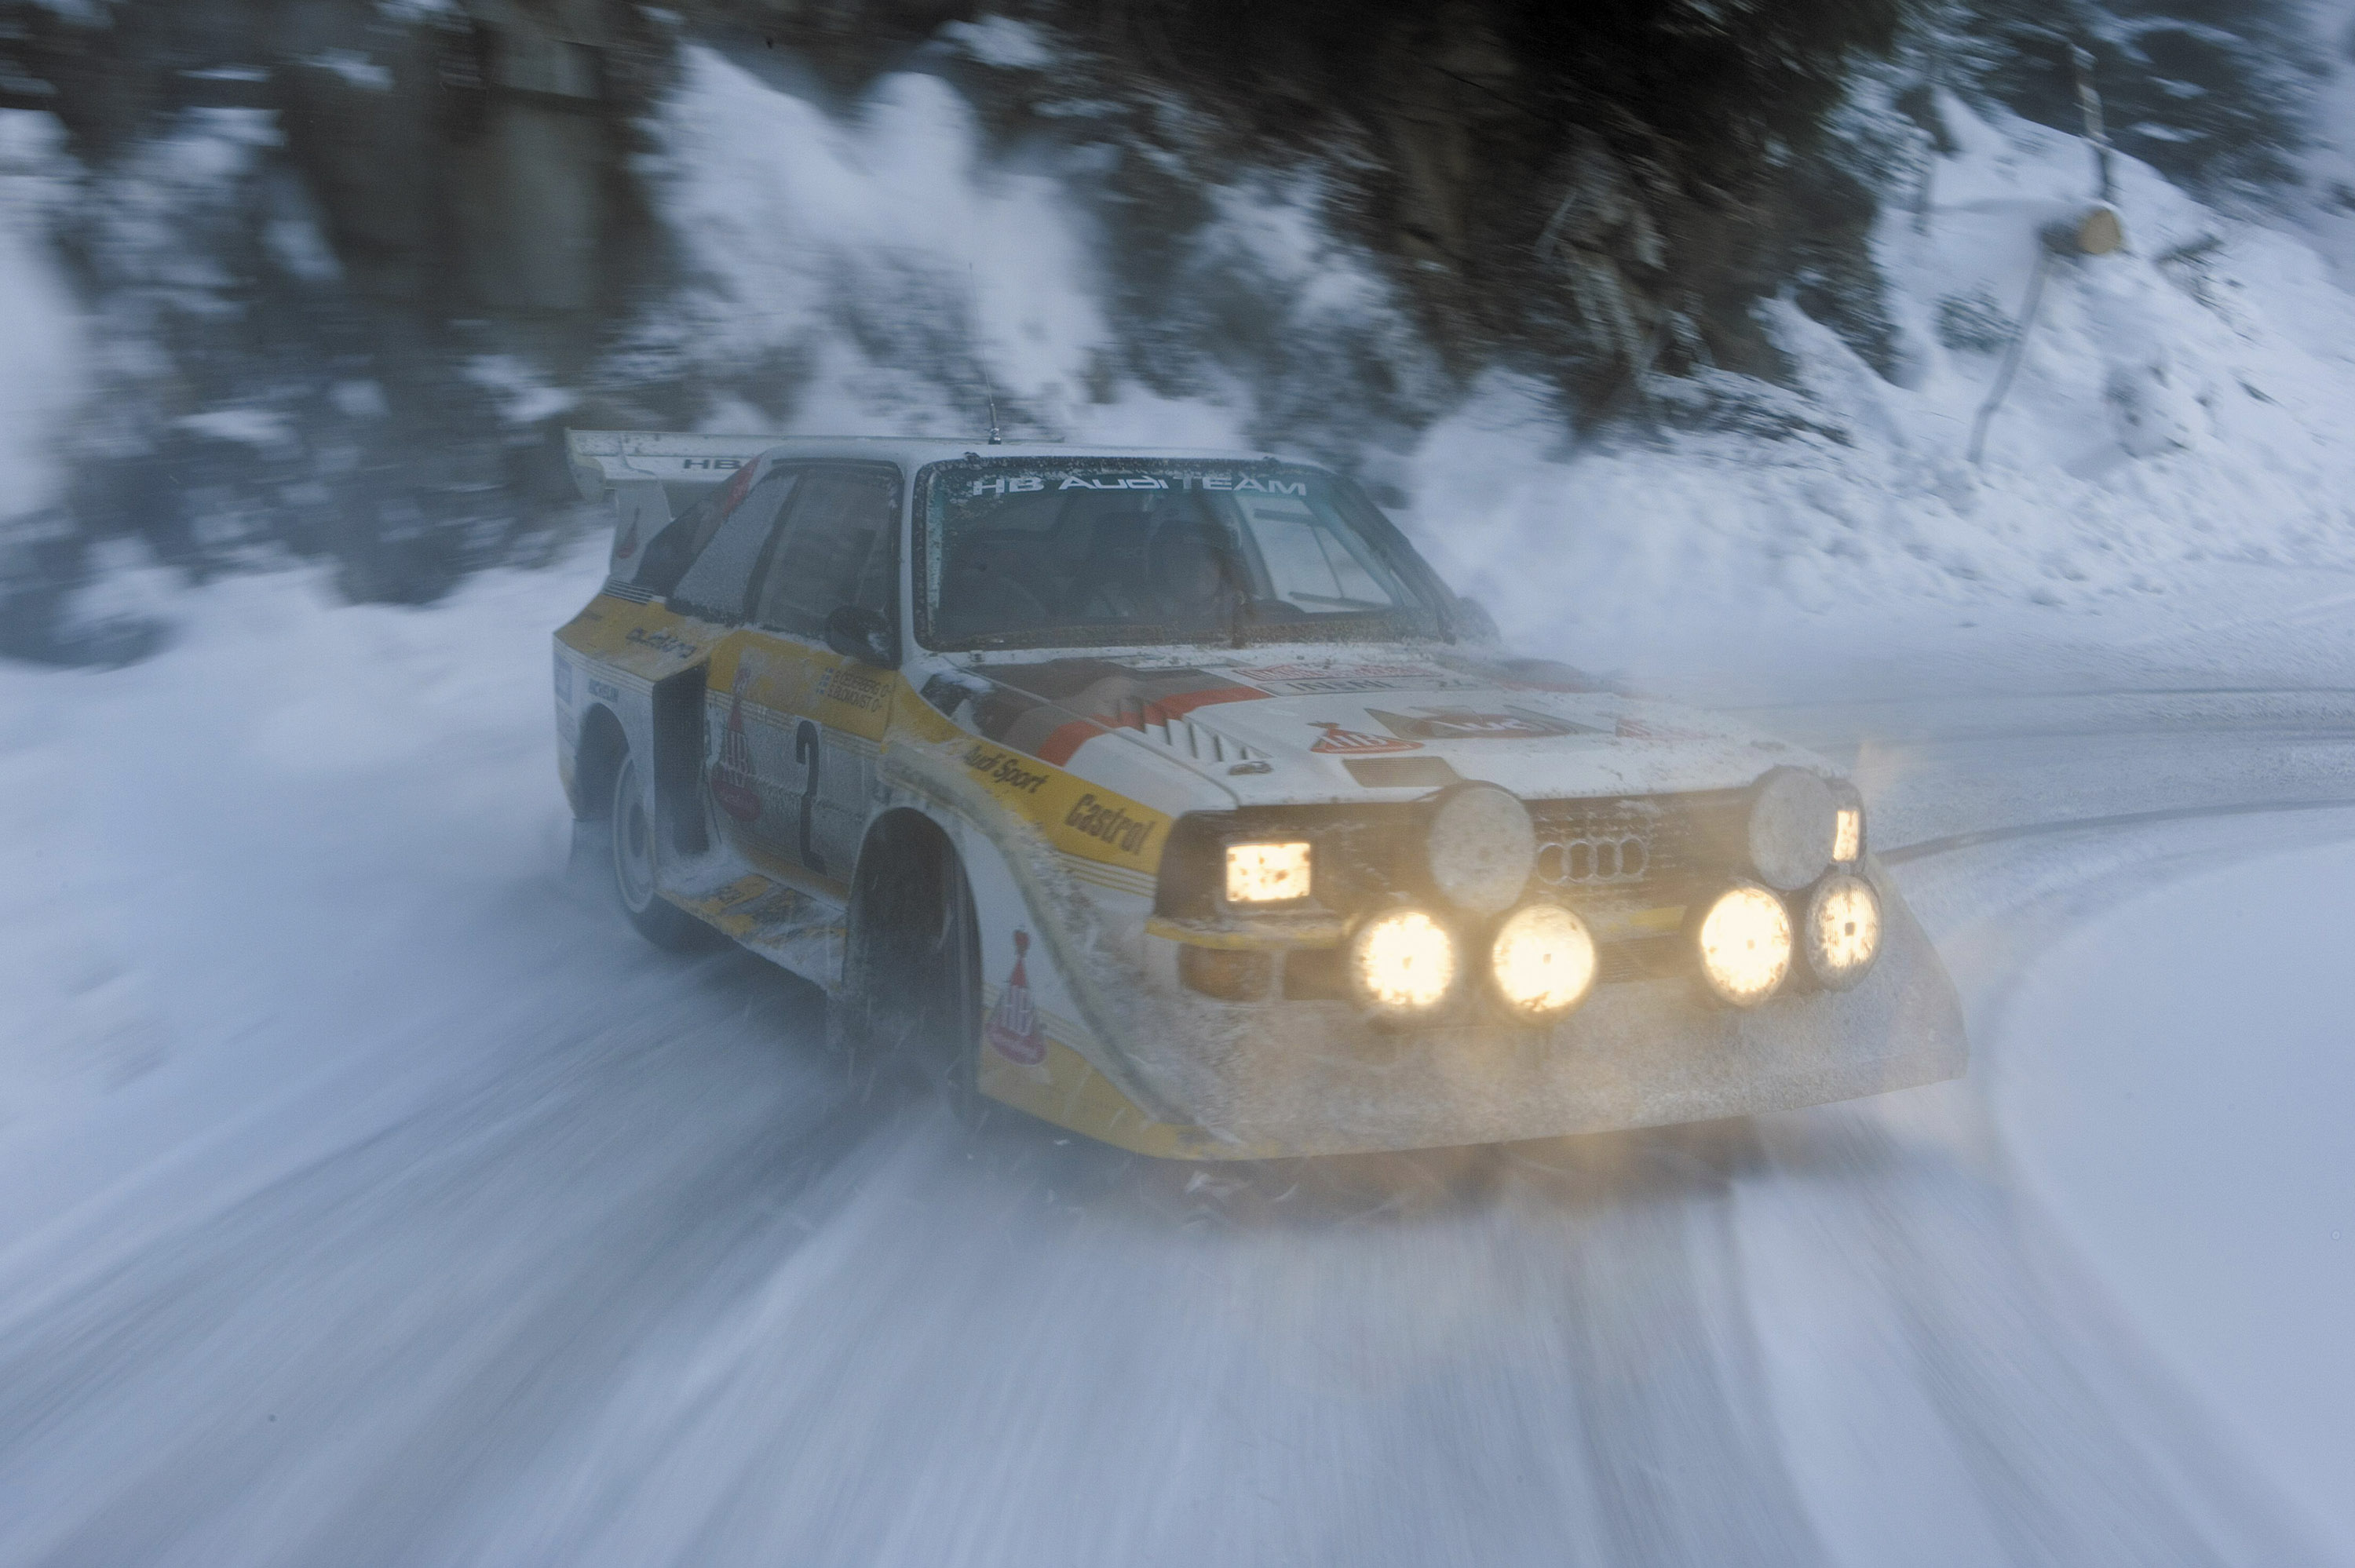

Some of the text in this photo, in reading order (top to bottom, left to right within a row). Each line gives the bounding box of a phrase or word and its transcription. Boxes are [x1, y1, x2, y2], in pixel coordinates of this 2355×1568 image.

[684, 458, 740, 470] HB
[973, 476, 1045, 496] HB
[1173, 476, 1307, 496] TEAM
[993, 758, 1050, 793] Sport
[1064, 793, 1156, 855] Castrol
